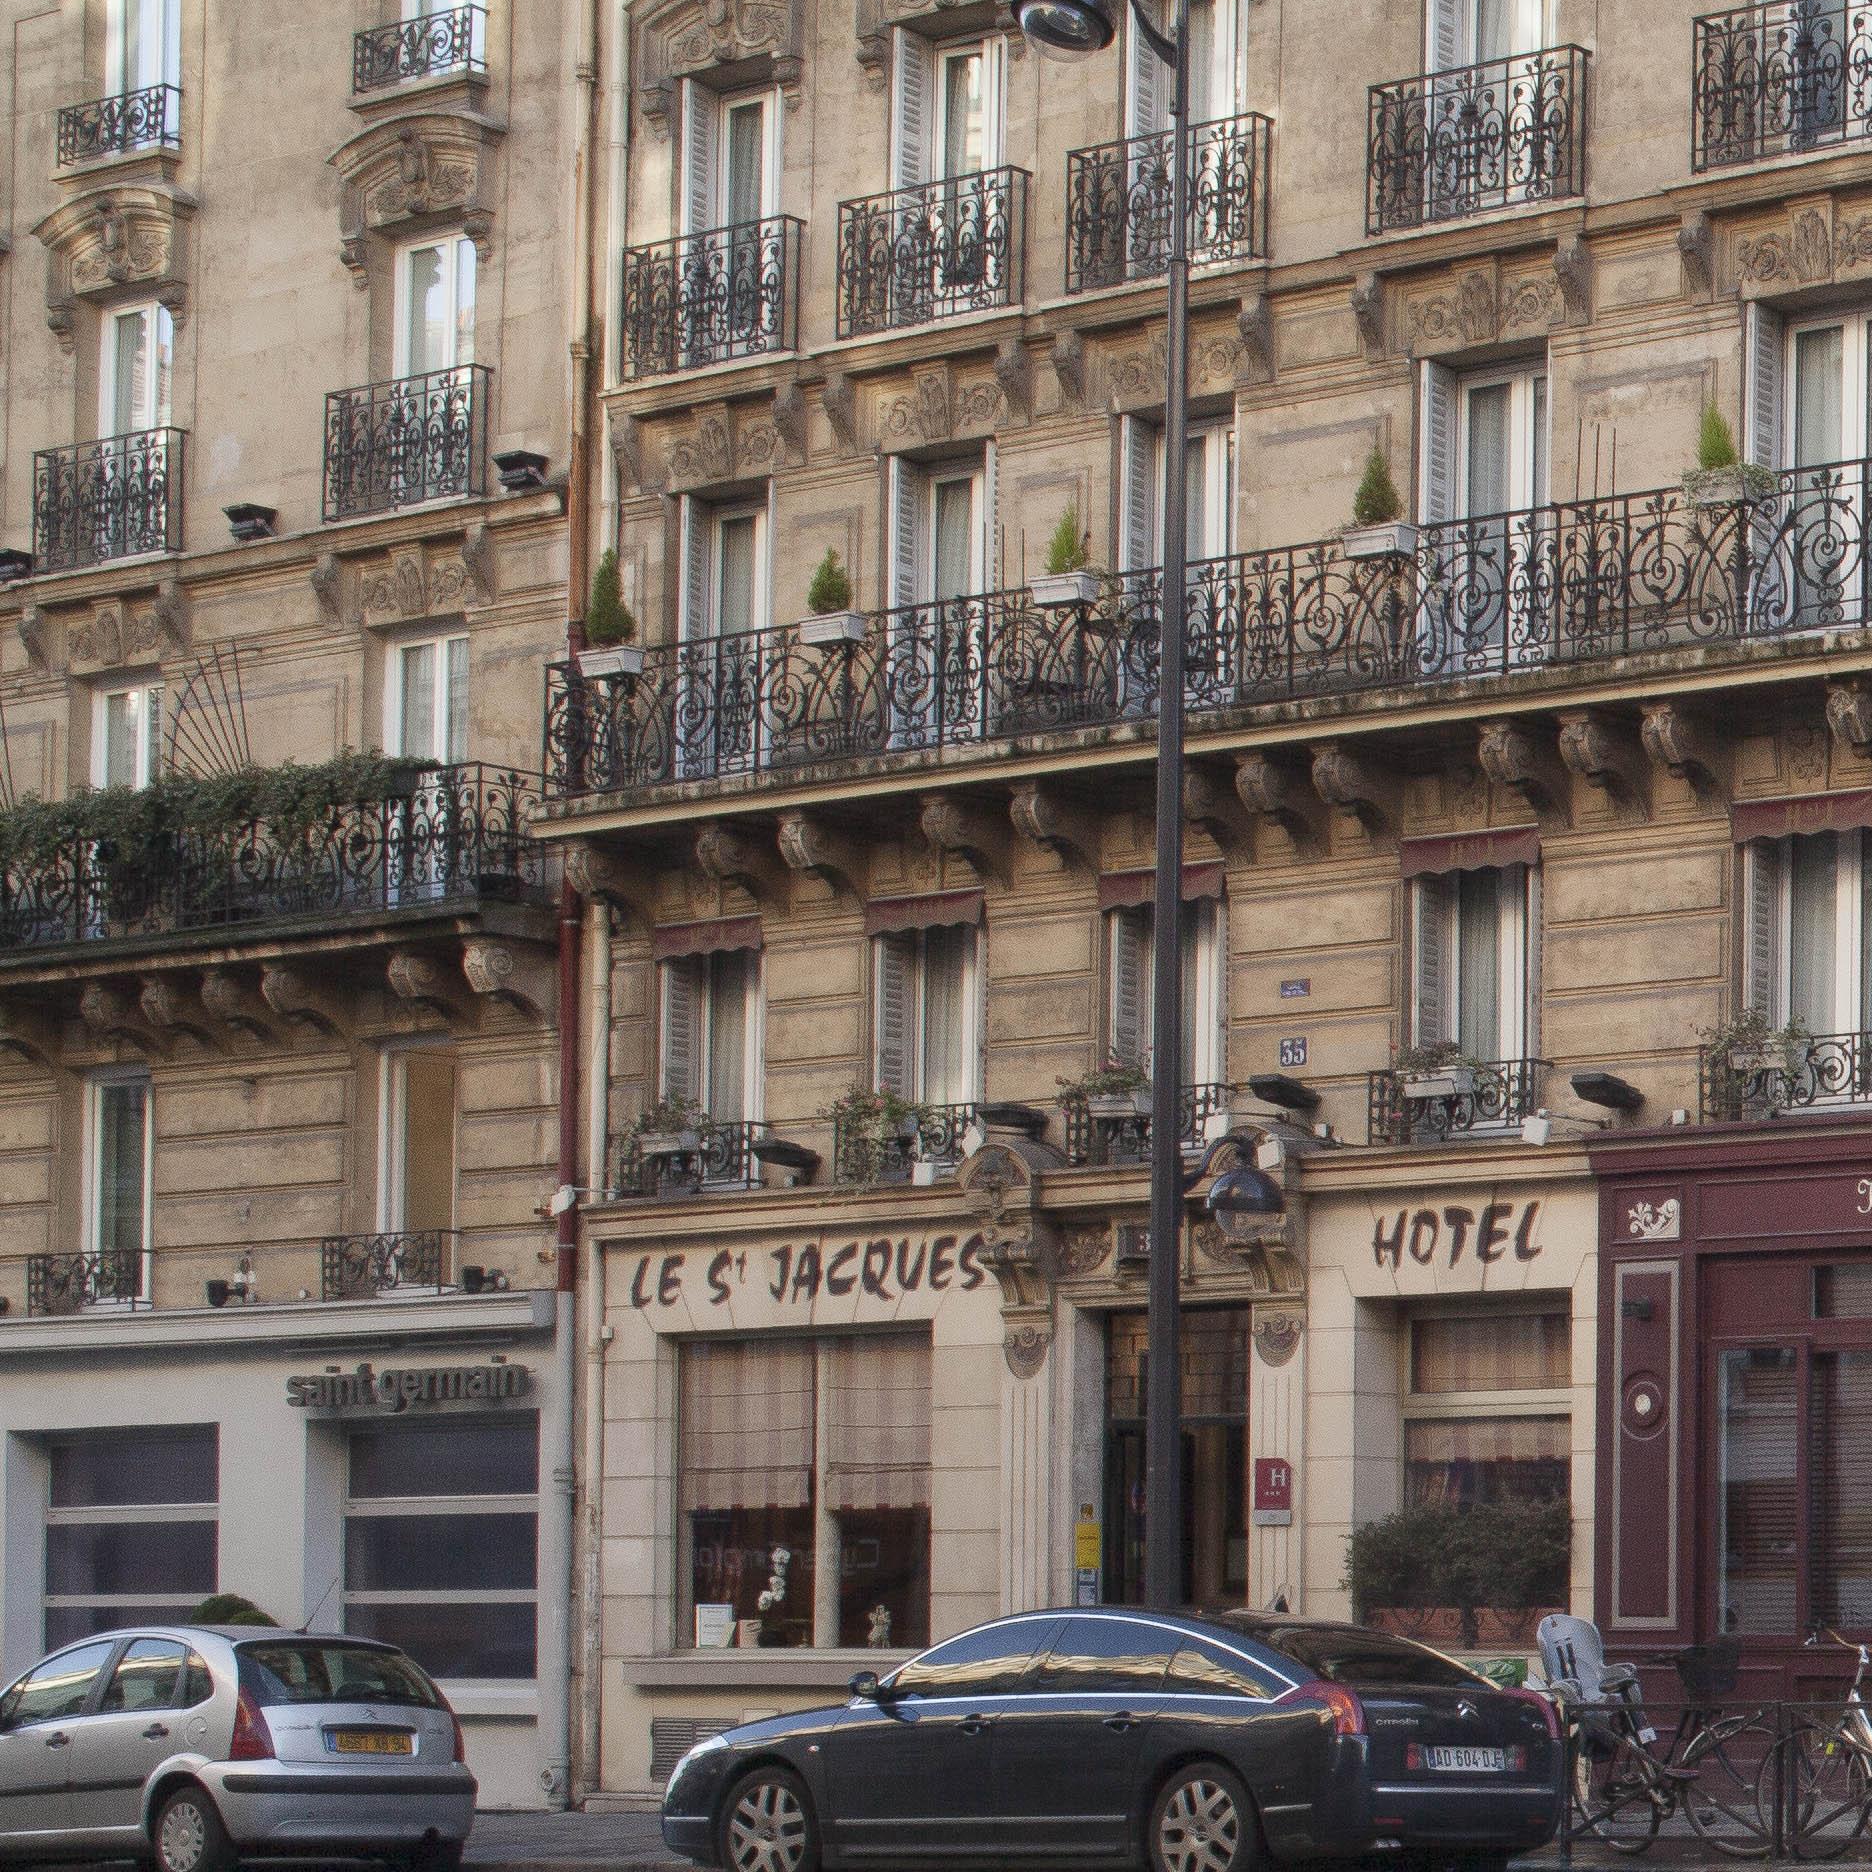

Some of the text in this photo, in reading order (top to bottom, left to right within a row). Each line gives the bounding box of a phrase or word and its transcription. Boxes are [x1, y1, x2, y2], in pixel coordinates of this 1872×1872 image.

[1372, 1200, 1543, 1273] HOTEL
[631, 1253, 686, 1308] LE
[769, 1232, 985, 1304] JACQUES
[287, 1355, 533, 1414] saint germain
[1271, 1468, 1287, 1487] H
